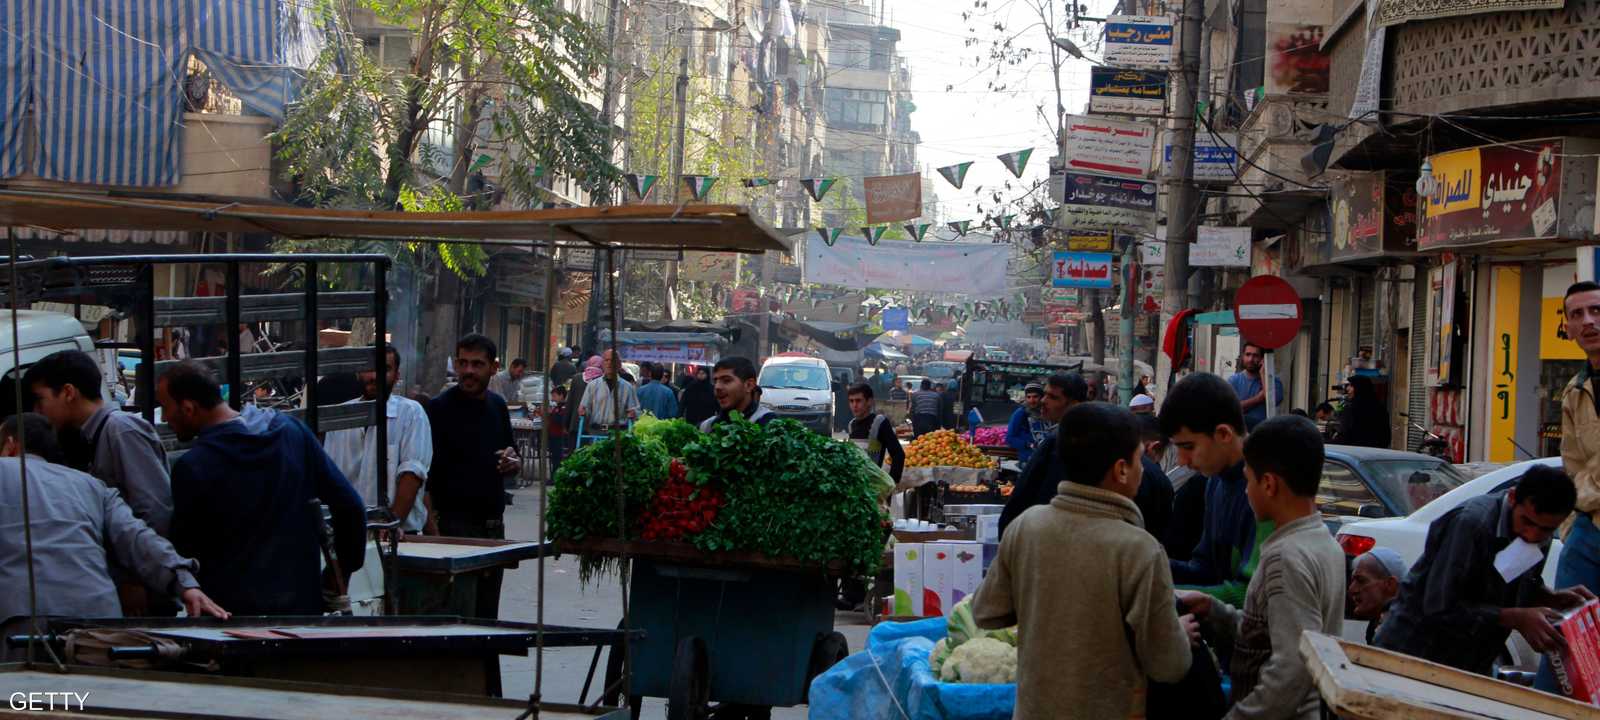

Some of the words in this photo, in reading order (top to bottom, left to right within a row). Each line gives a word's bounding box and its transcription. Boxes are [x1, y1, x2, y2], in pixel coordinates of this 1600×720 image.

[1432, 168, 1472, 209] للصراف
[1482, 162, 1532, 219] جنيدي
[1067, 256, 1108, 283] صيدلية
